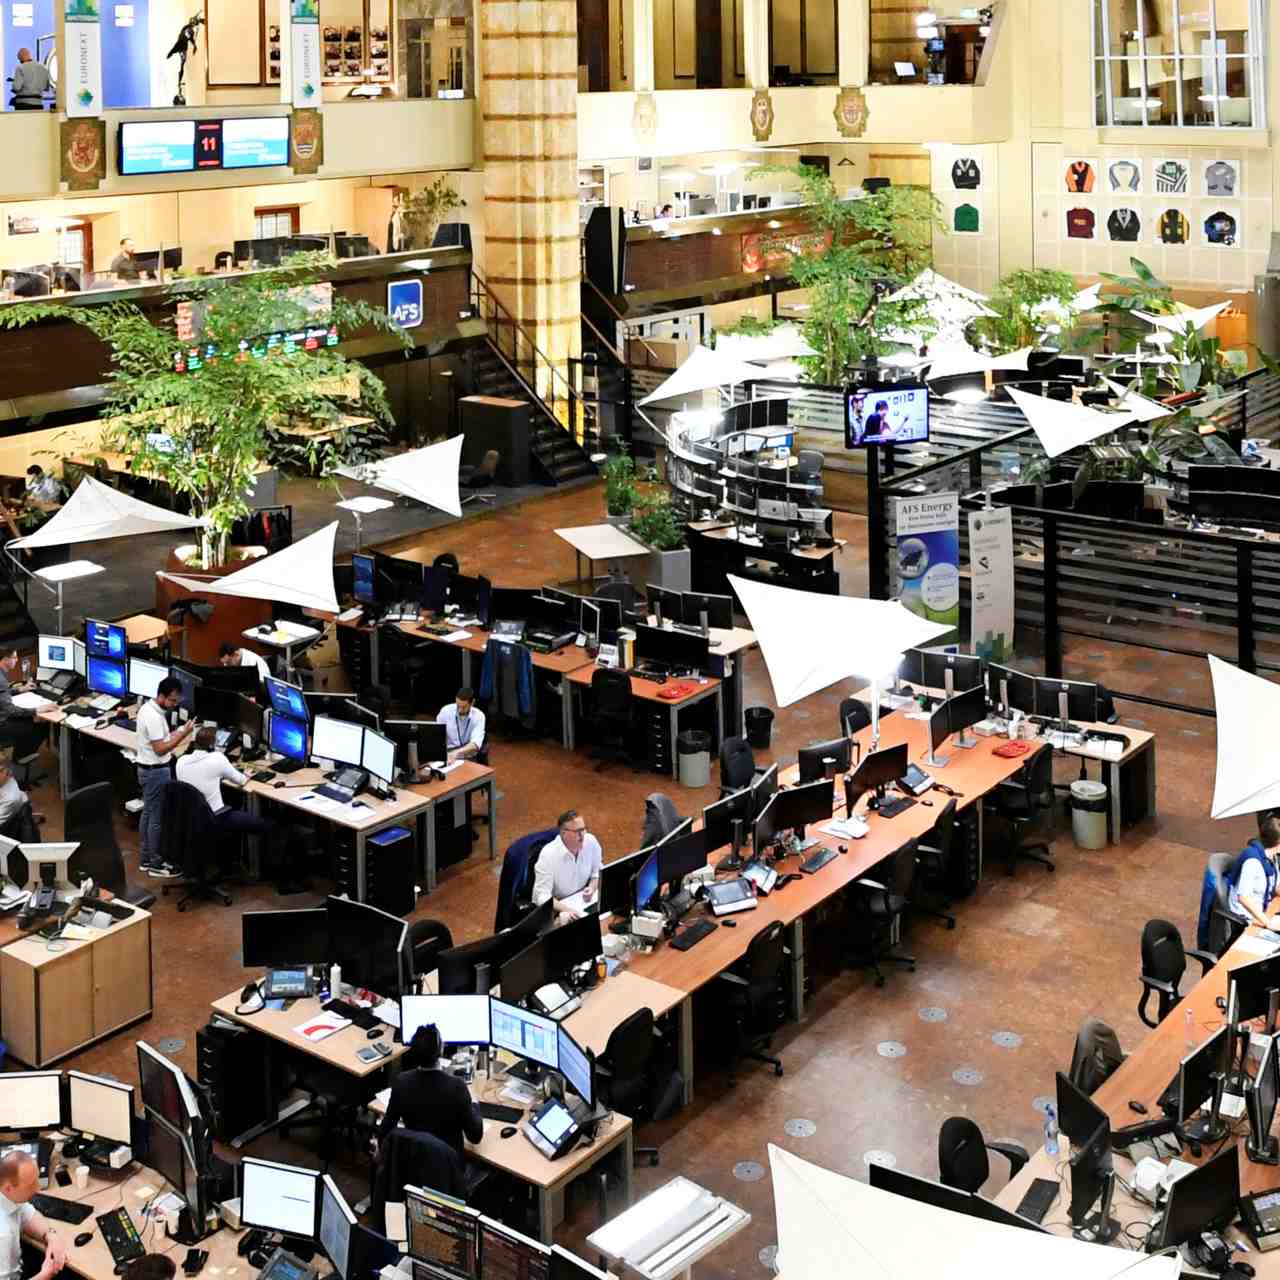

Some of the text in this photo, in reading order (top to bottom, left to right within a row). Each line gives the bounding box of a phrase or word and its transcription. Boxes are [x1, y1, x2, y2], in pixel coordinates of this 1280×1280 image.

[392, 303, 419, 322] AFS
[902, 502, 953, 515] AFS Energy
